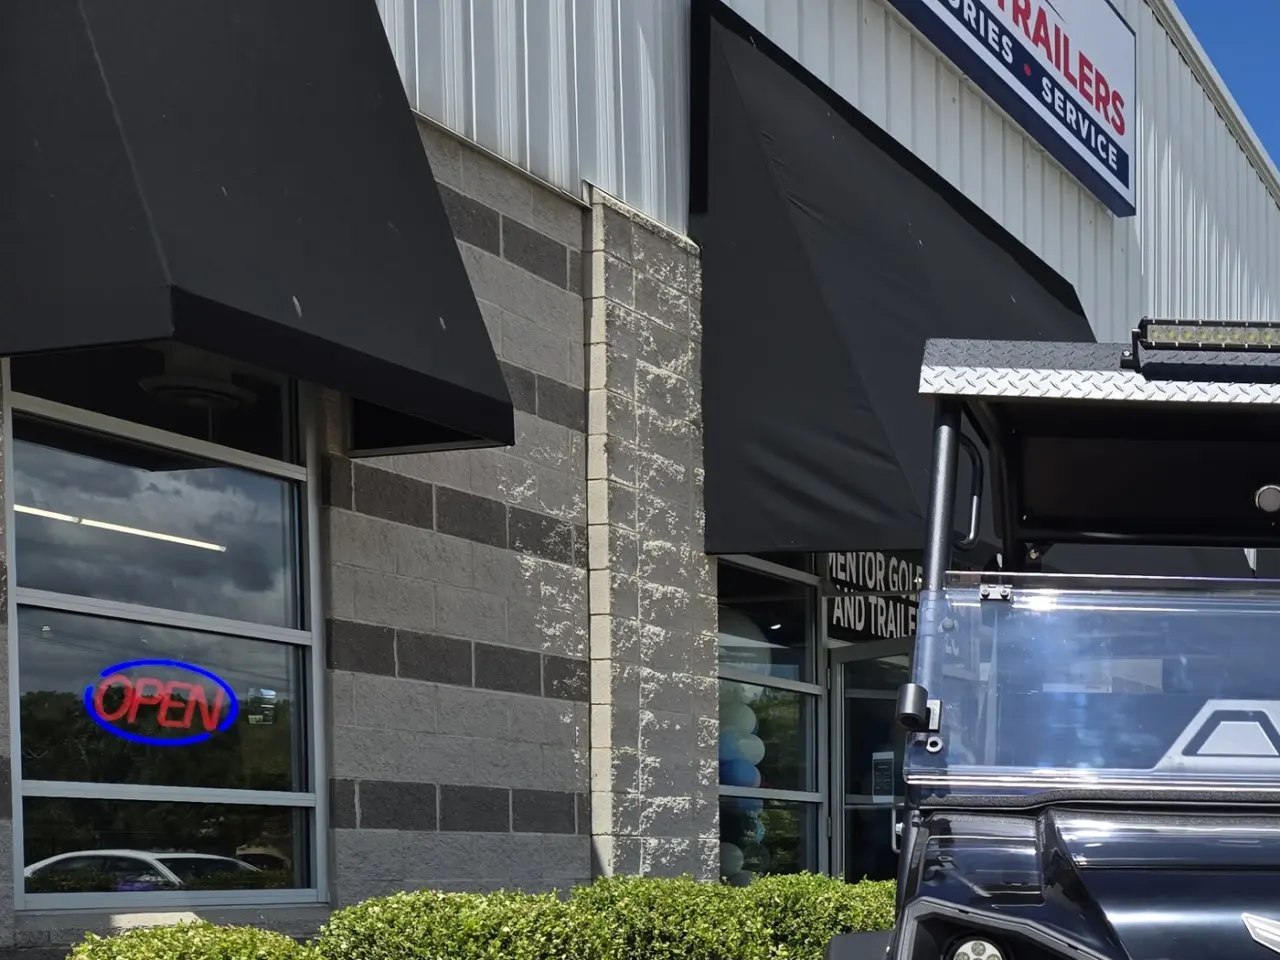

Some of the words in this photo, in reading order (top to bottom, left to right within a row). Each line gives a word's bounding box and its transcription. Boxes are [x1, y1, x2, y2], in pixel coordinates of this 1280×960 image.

[1041, 76, 1118, 171] SERVICE
[833, 584, 866, 631] AND
[94, 674, 225, 731] OPEN
